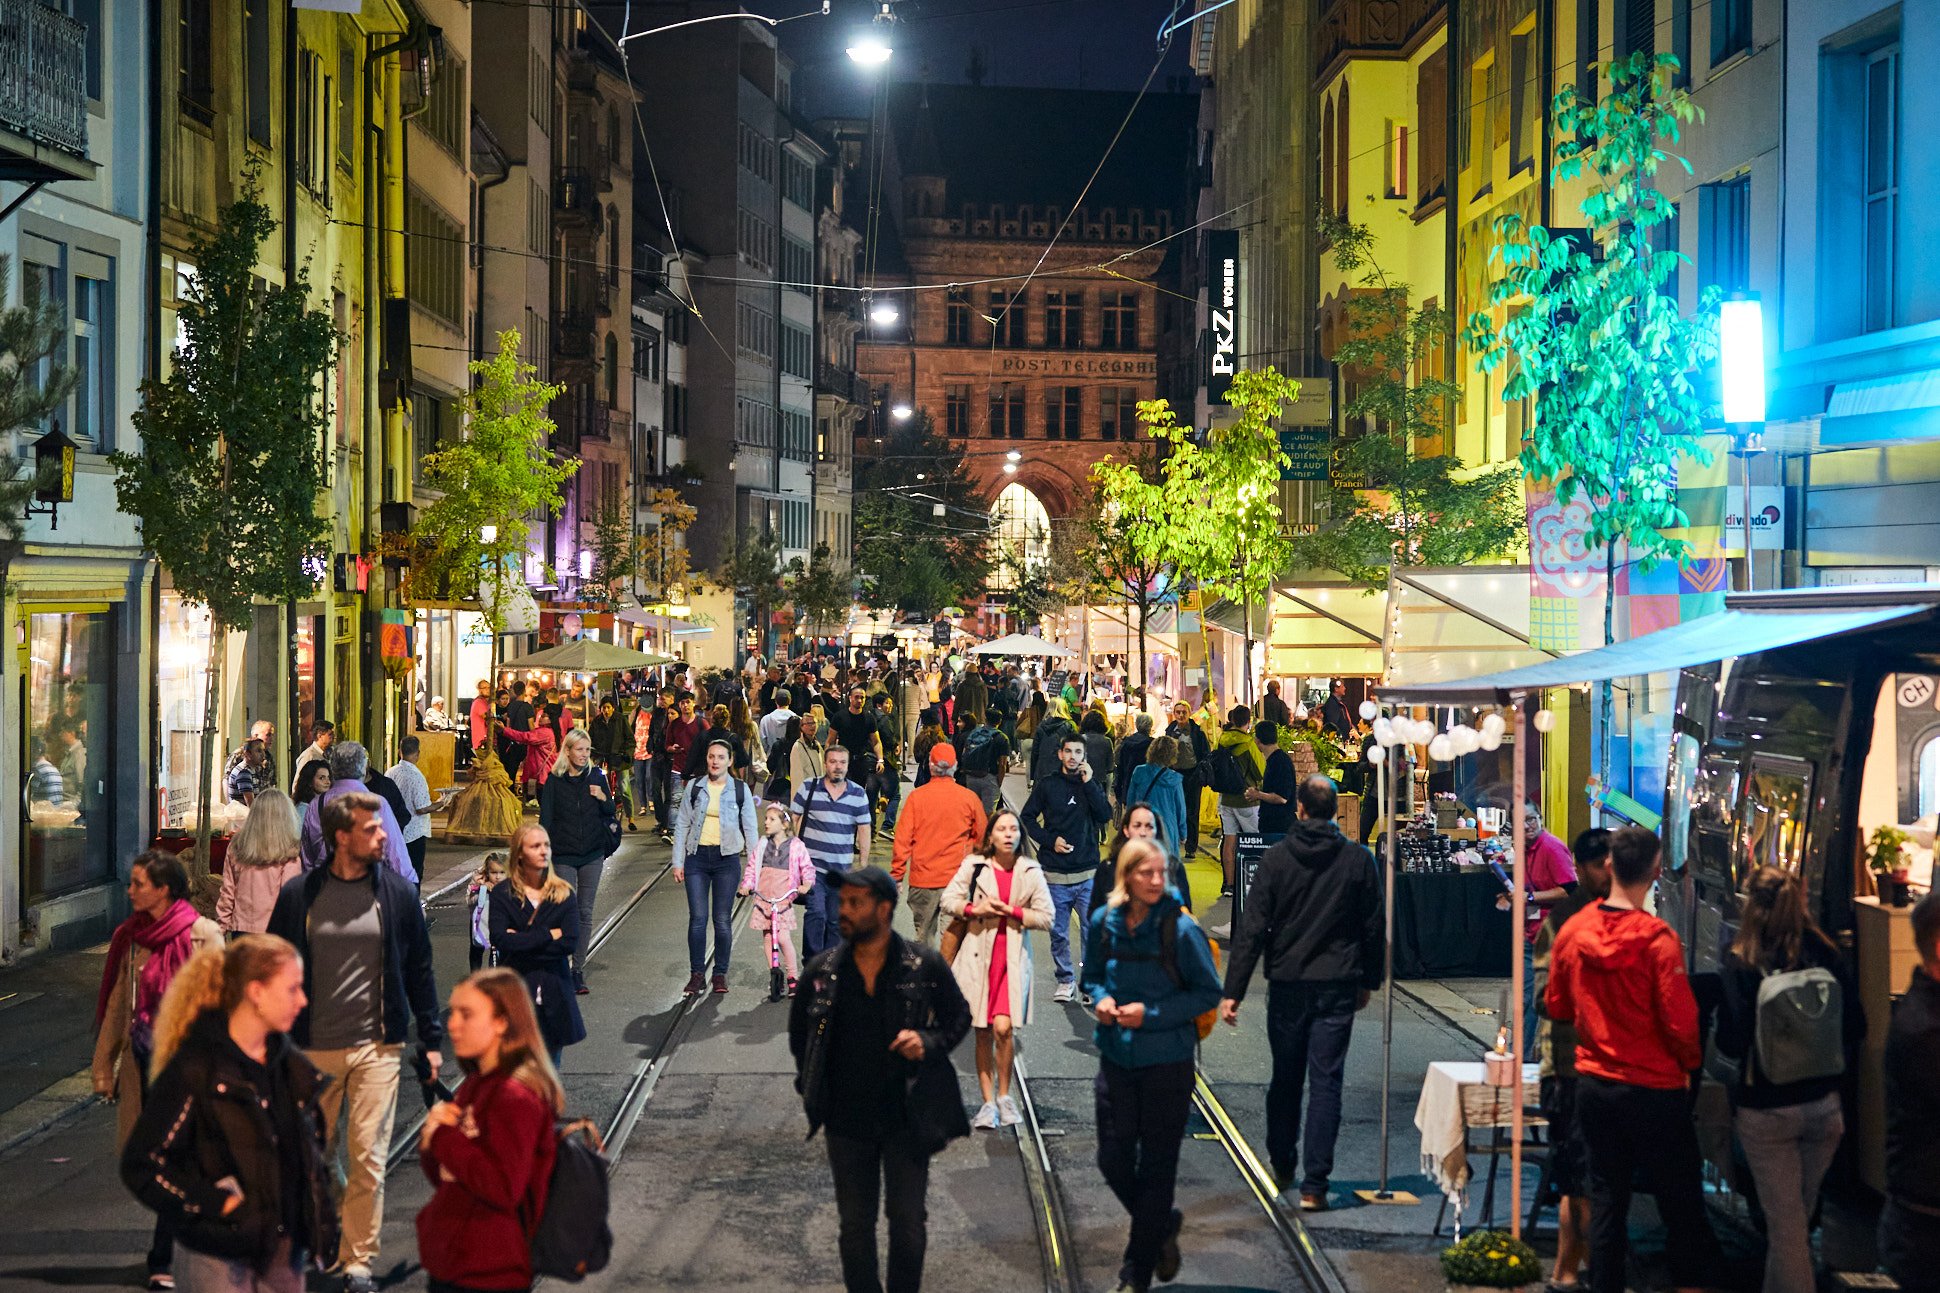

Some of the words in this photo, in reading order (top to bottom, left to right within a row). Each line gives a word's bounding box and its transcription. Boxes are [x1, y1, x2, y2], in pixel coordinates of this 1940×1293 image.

[1223, 258, 1234, 308] WOMEN
[1213, 310, 1234, 376] PKZ
[1334, 479, 1364, 488] Francis
[1904, 680, 1929, 703] CH
